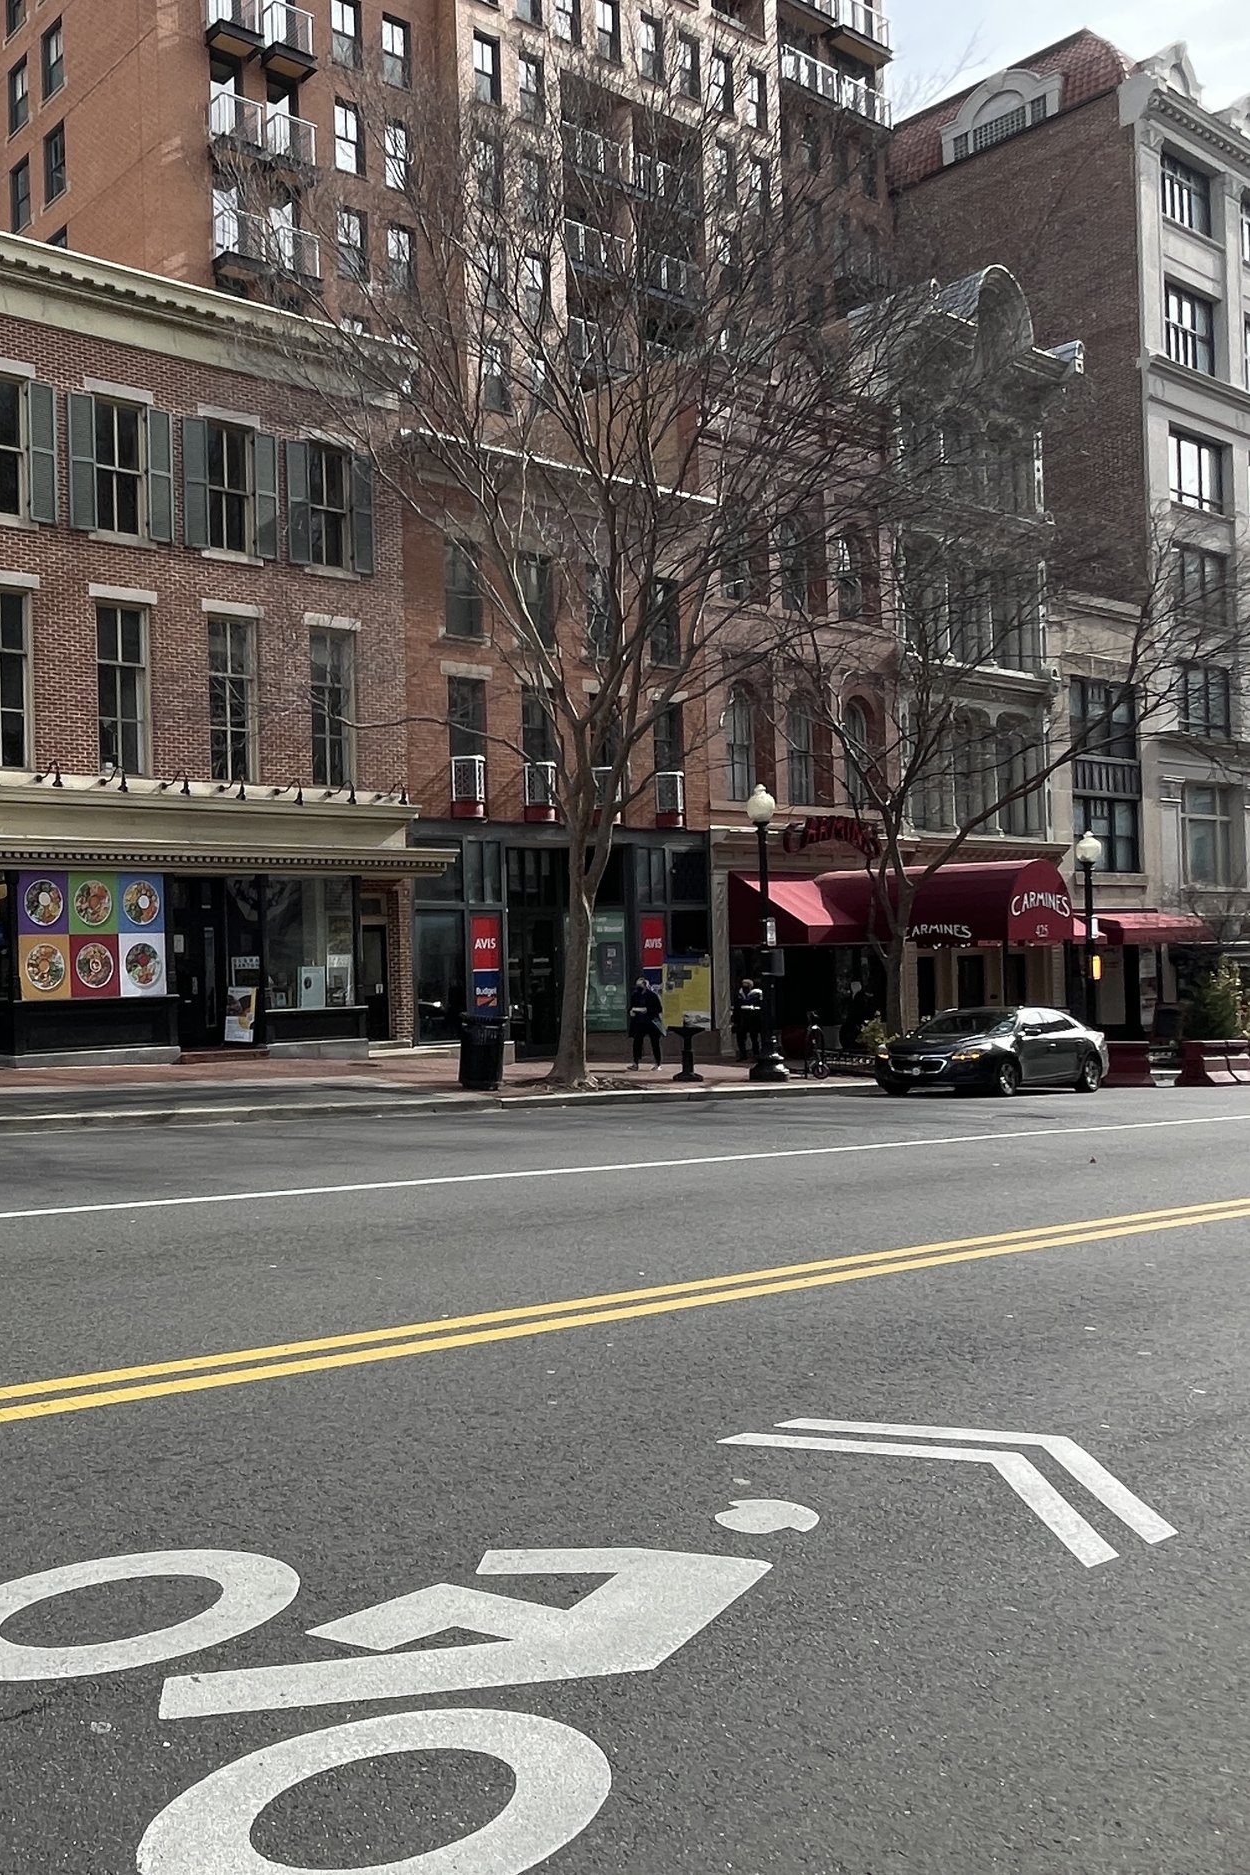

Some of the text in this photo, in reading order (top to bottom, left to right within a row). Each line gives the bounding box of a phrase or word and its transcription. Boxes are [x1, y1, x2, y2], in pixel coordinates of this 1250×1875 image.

[1011, 891, 1071, 917] CARMINES
[474, 937, 497, 950] AVIS
[644, 937, 663, 950] AVIS
[475, 986, 498, 998] Budget
